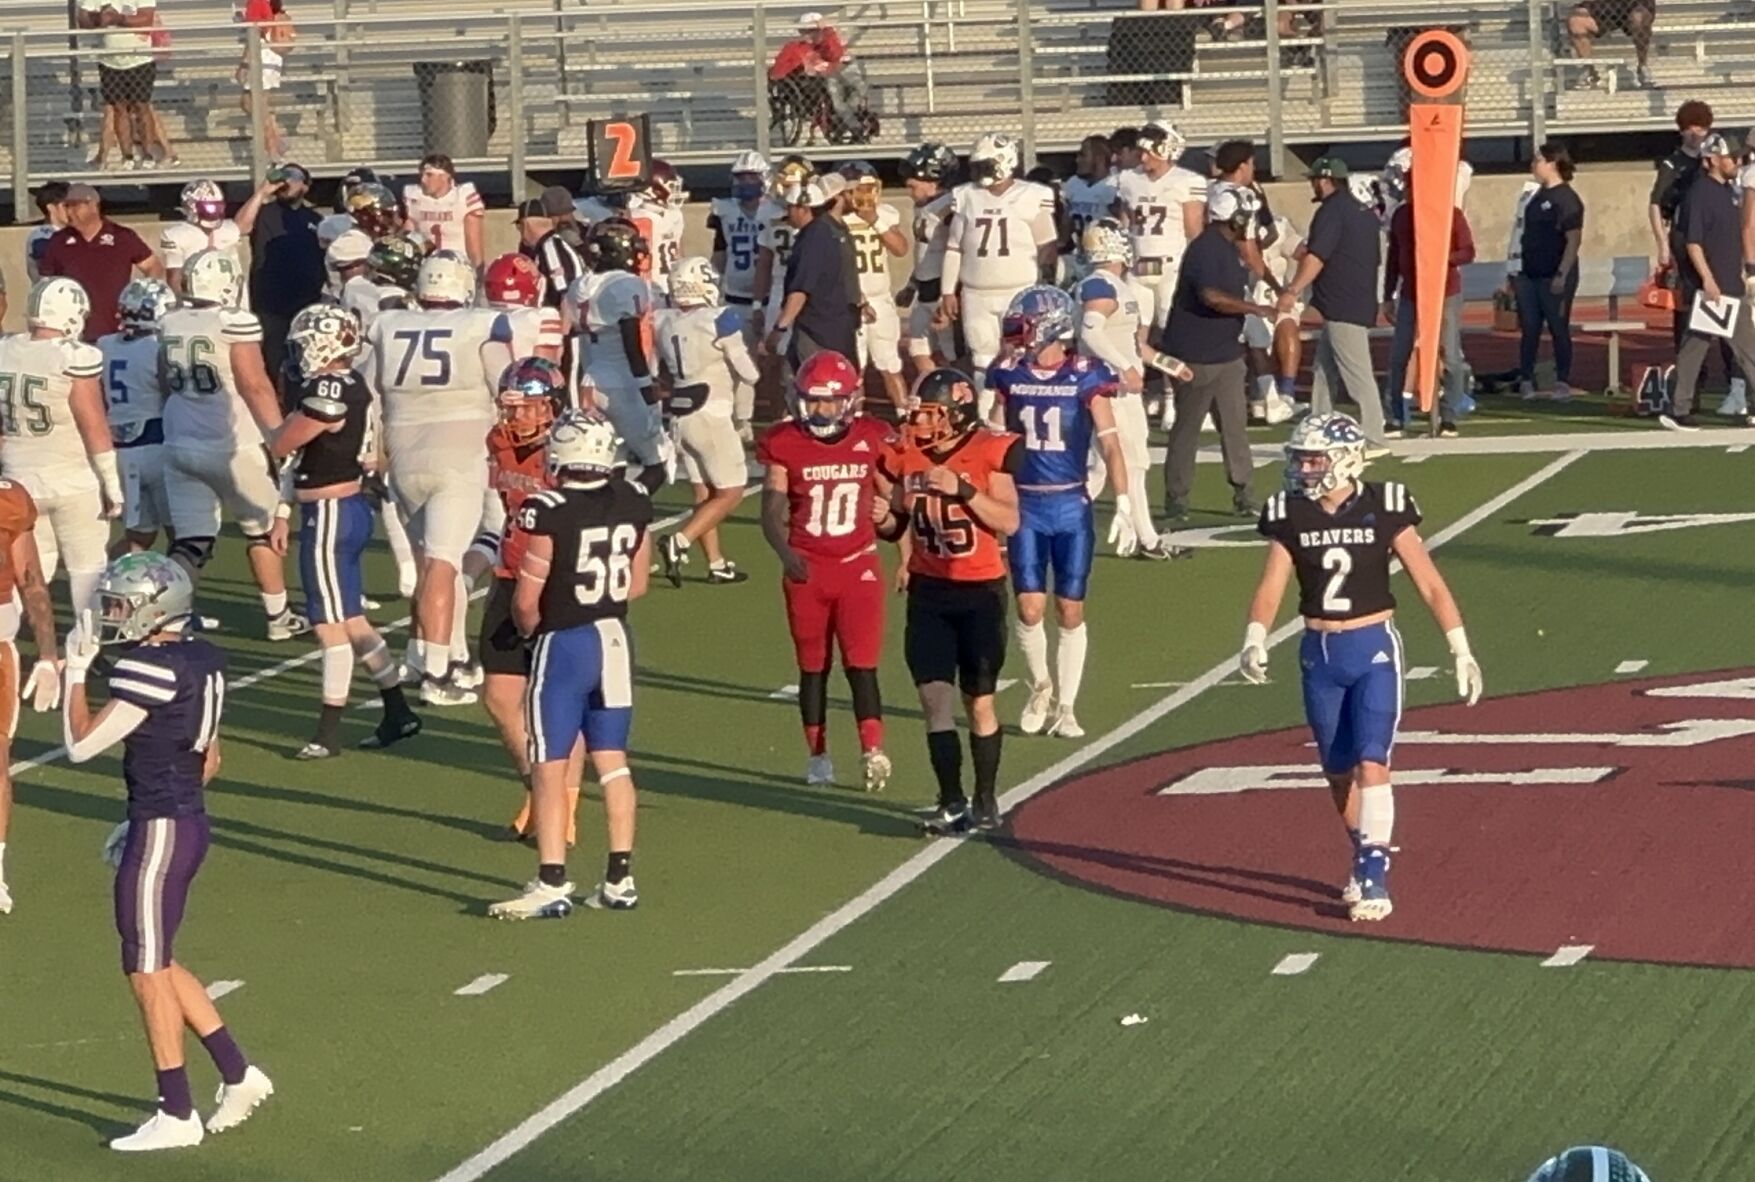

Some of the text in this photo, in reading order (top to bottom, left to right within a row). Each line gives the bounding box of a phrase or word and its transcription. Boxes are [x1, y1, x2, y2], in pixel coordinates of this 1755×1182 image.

[604, 122, 641, 179] 2
[975, 217, 1010, 257] 71
[110, 359, 128, 404] 5
[159, 335, 224, 395] 56
[393, 329, 453, 387] 75
[0, 371, 54, 437] 75
[317, 380, 342, 399] 60
[1019, 405, 1067, 452] 11
[802, 463, 869, 482] COUGARS
[805, 482, 861, 538] 10
[911, 493, 978, 559] 45
[1300, 527, 1376, 547] BEAVERS
[574, 523, 637, 605] 56
[1322, 547, 1352, 612] 2
